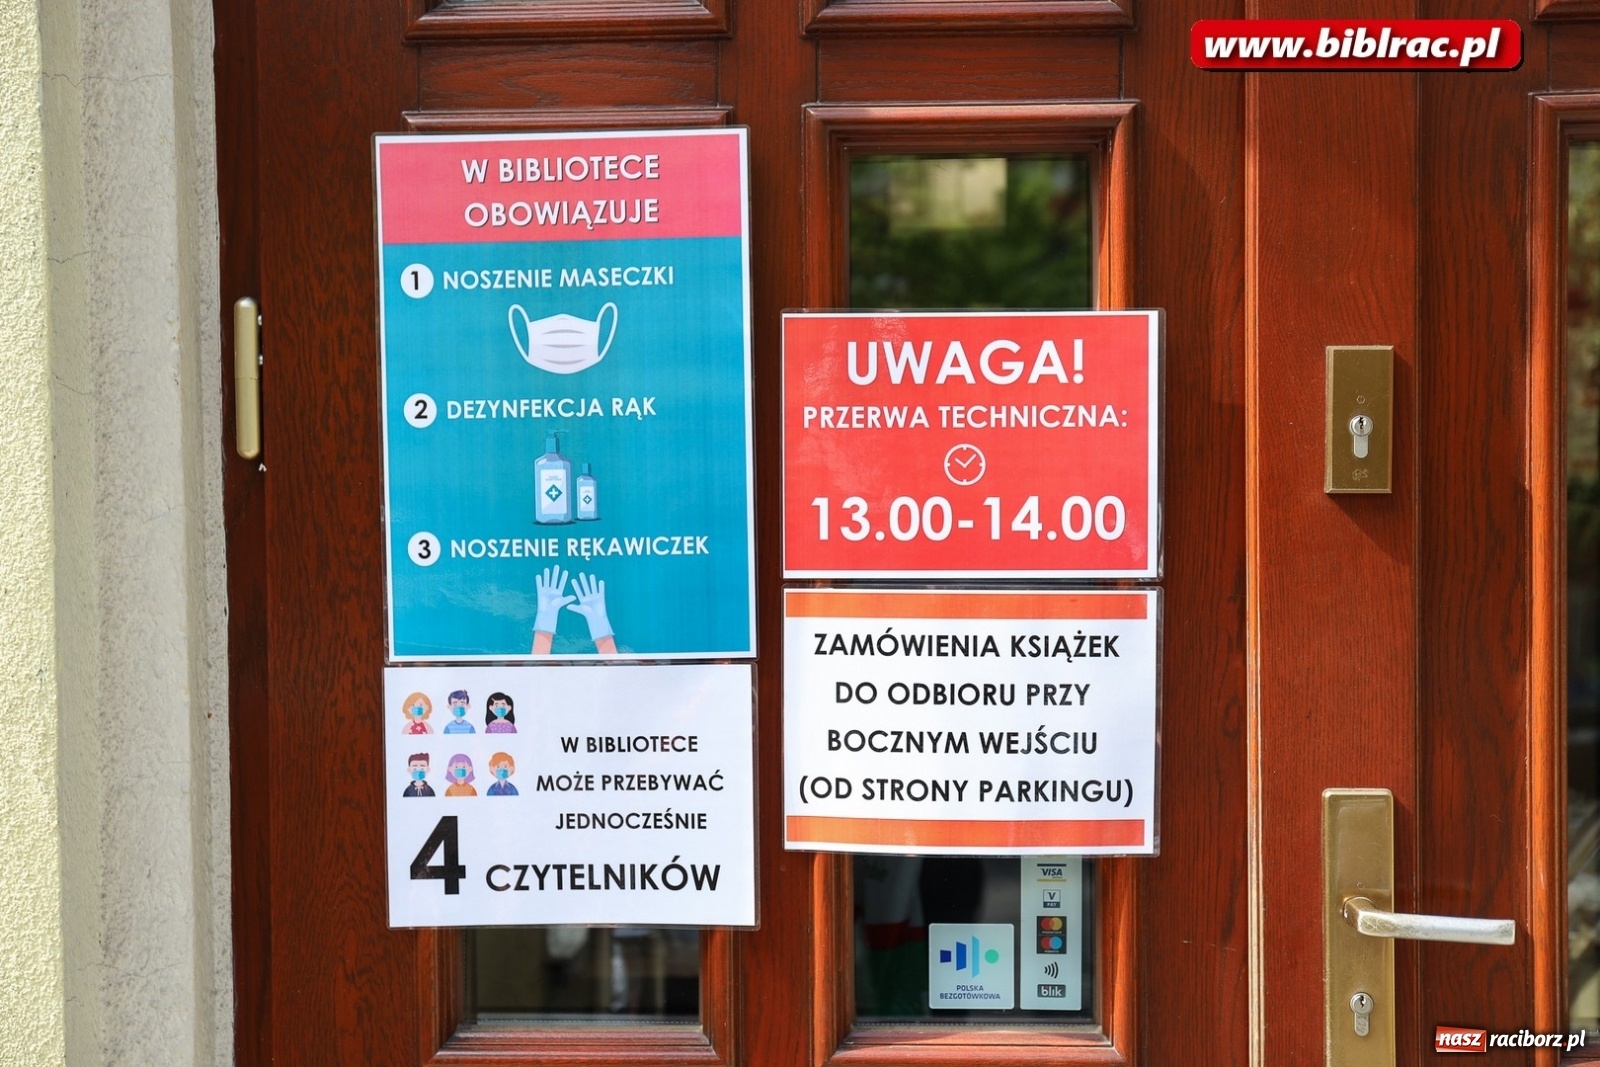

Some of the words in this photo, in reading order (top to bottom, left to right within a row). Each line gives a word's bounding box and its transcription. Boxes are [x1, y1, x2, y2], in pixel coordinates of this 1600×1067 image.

[461, 158, 489, 183] W
[499, 154, 660, 183] BIBLIOTECE
[463, 198, 660, 230] OBOWIĄZUJE
[411, 270, 420, 290] 1
[443, 269, 552, 290] NOSZENIE
[559, 266, 674, 288] MASECZKI
[847, 339, 1085, 386] UWAGA!
[414, 400, 428, 420] 2
[447, 398, 603, 420] DEZYNFEKCJA
[612, 397, 657, 421] RĄK
[803, 406, 930, 429] PRZERWA
[938, 405, 1128, 429] TECHNICZNA:
[811, 495, 1127, 542] 13.00-14.00
[418, 540, 431, 559] 3
[450, 538, 559, 558] NOSZENIE
[567, 535, 709, 561] RĘKAWICZEK
[814, 627, 1000, 657] ZAMÓWIENIA
[1010, 630, 1120, 663] KSIĄŻEK
[835, 681, 878, 705] DO
[887, 682, 1016, 706] ODBIORU
[1026, 683, 1091, 706] PRZY
[561, 736, 579, 753] W
[586, 735, 698, 753] BIBLIOTECE
[827, 729, 970, 754] BOCZNYM
[979, 725, 1097, 755] WEJŚCIU
[536, 771, 595, 791] MOŻE
[602, 769, 724, 791] PRZEBYWAĆ
[799, 775, 852, 803] (OD
[862, 777, 969, 802] STRONY
[979, 778, 1134, 808] PARKINGU)
[555, 808, 707, 830] JEDNOCZEŚNIE
[409, 815, 467, 895] 4
[485, 855, 721, 891] CZYTELNIKÓW
[1041, 868, 1063, 876] VISA
[1047, 891, 1056, 900] V
[939, 992, 1001, 1000] BEZGOTÓWKOWA
[956, 984, 984, 992] POLSKA
[1041, 985, 1063, 997] blik
